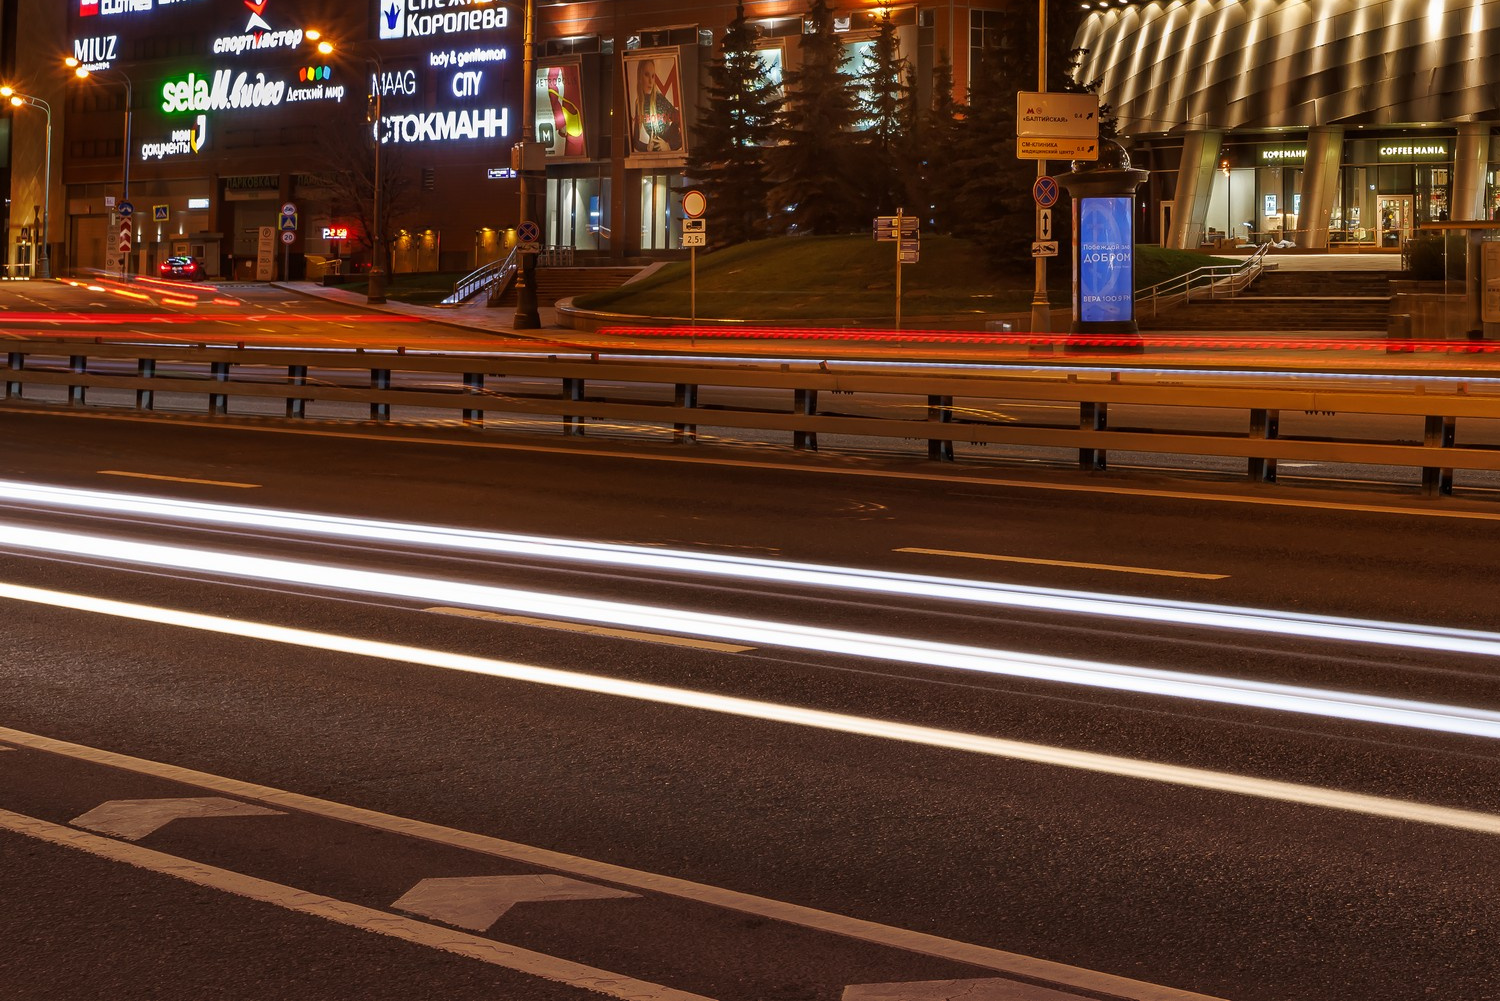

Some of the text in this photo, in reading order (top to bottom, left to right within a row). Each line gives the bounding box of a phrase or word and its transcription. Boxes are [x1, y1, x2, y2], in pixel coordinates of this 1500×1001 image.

[406, 7, 508, 37] Королева
[74, 35, 117, 62] MIUZ
[430, 48, 506, 68] lady & gentleman
[162, 73, 209, 112] sela
[286, 85, 344, 102] Детский мир
[372, 70, 416, 97] MAAG
[452, 71, 482, 97] CITY
[1263, 150, 1307, 159] КОФЕМАНИ
[1083, 243, 1120, 251] Побеждай
[1083, 253, 1131, 263] ДОБРОМ
